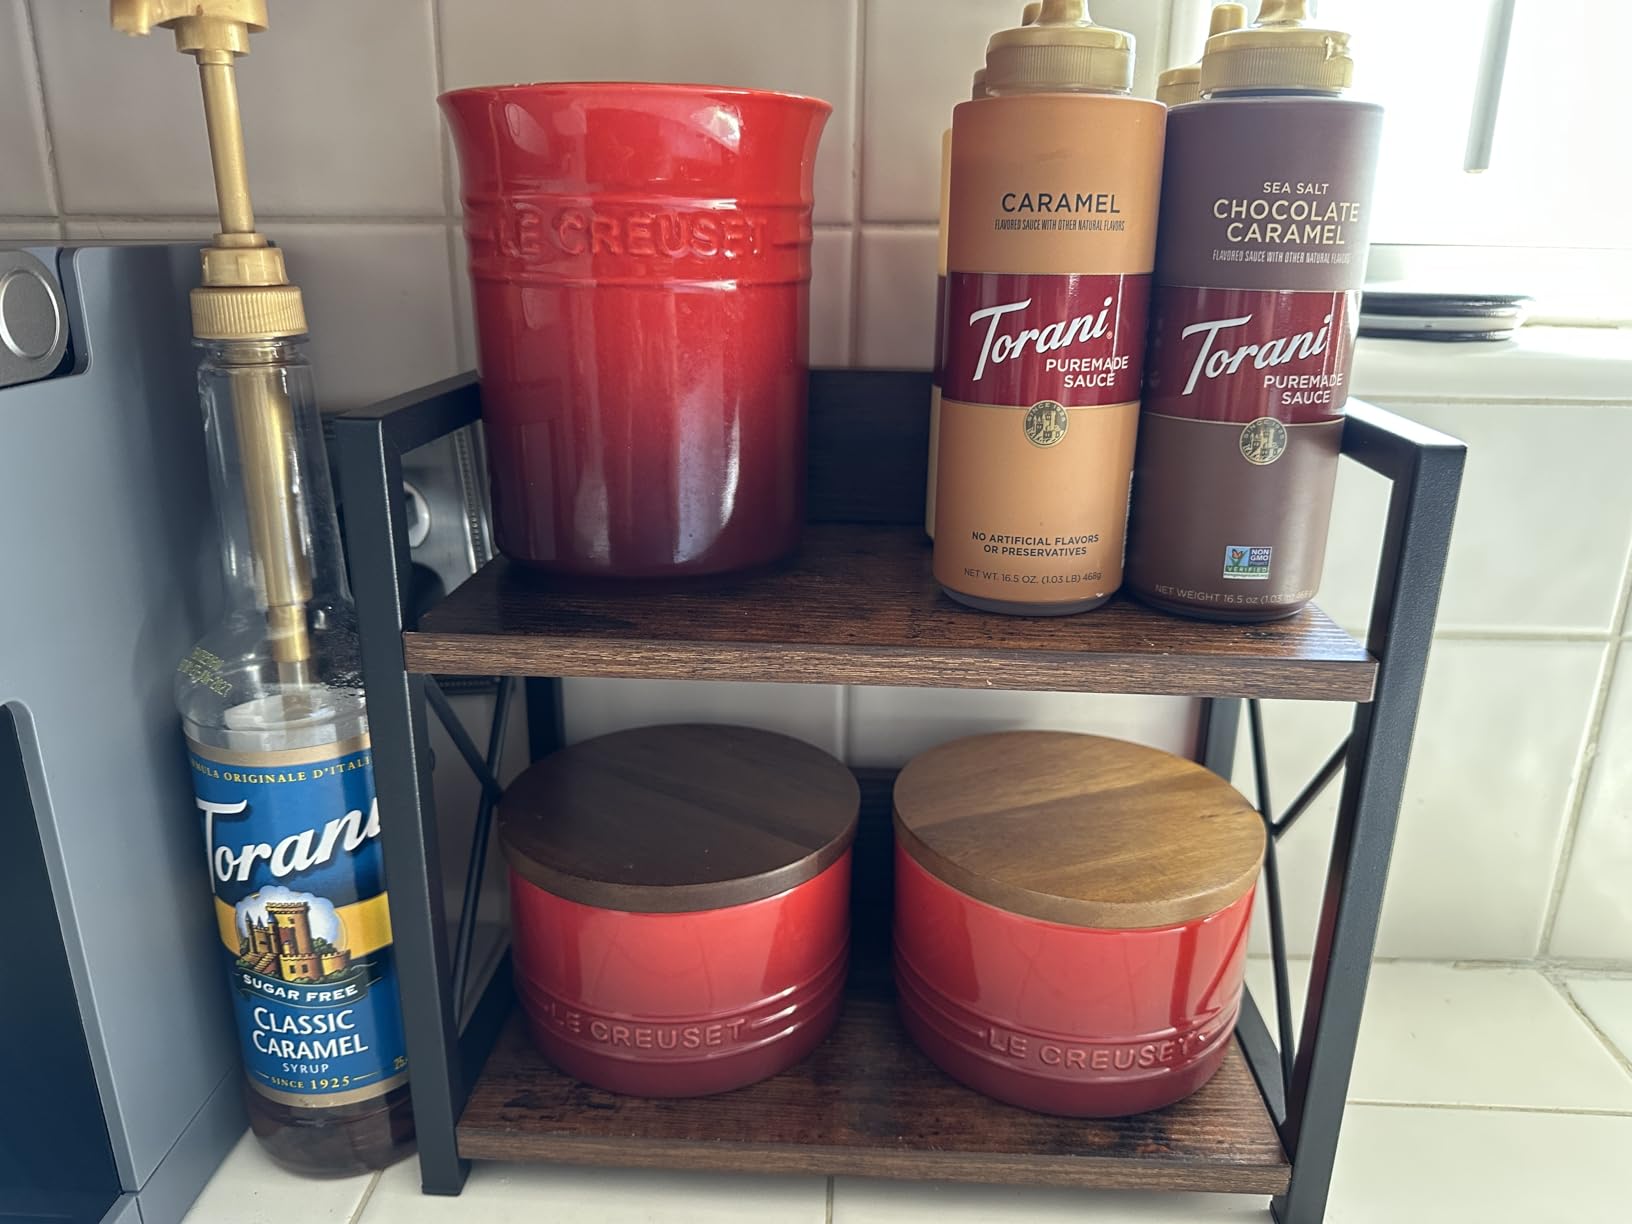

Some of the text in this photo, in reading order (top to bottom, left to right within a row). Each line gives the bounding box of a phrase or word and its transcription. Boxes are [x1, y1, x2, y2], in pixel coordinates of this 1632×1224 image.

[1263, 182, 1329, 195] SEA SALT
[1001, 192, 1121, 214] CARAMEL
[1213, 199, 1360, 222] CHOCOLATE
[499, 209, 767, 258] LE CREUSET
[994, 219, 1125, 232] FLAVORED SAUCE WITH OTHER NATURAL FLAVORS
[1226, 223, 1345, 245] CARAMEL
[1212, 249, 1244, 262] FLAVORED
[1244, 250, 1266, 263] SAUCE
[1266, 251, 1283, 263] WITH
[1284, 251, 1304, 264] OTHER
[1305, 252, 1330, 265] NATURAL
[969, 296, 1113, 382] Torani
[1045, 355, 1130, 373] PUREMADE
[1181, 314, 1333, 396] Torani
[1063, 373, 1115, 388] SAUCE
[1263, 373, 1344, 389] PUREMADE
[1281, 391, 1331, 405] SAUCE
[972, 531, 1099, 546] NO ARTIFICIAL FLAVORS
[984, 545, 1087, 557] OR PRESERVATIVES
[964, 568, 980, 578] NET
[1001, 574, 1019, 583] 16.5
[1065, 574, 1081, 584] LB)
[1155, 584, 1173, 595] NET
[1176, 589, 1220, 601] WEIGHT
[1223, 594, 1243, 604] 16.5
[223, 770, 307, 784] ORIGINALE
[313, 756, 370, 779] D'ITALI
[243, 974, 358, 1002] SUGAR FREE
[253, 1006, 356, 1035] CLASSIC
[552, 1001, 745, 1049] LE CREUSET
[252, 1029, 369, 1060] CARAMEL
[988, 1027, 1198, 1071] LE CREUSET
[282, 1062, 329, 1074] SYRUP
[271, 1075, 350, 1090] SINCE 1925
